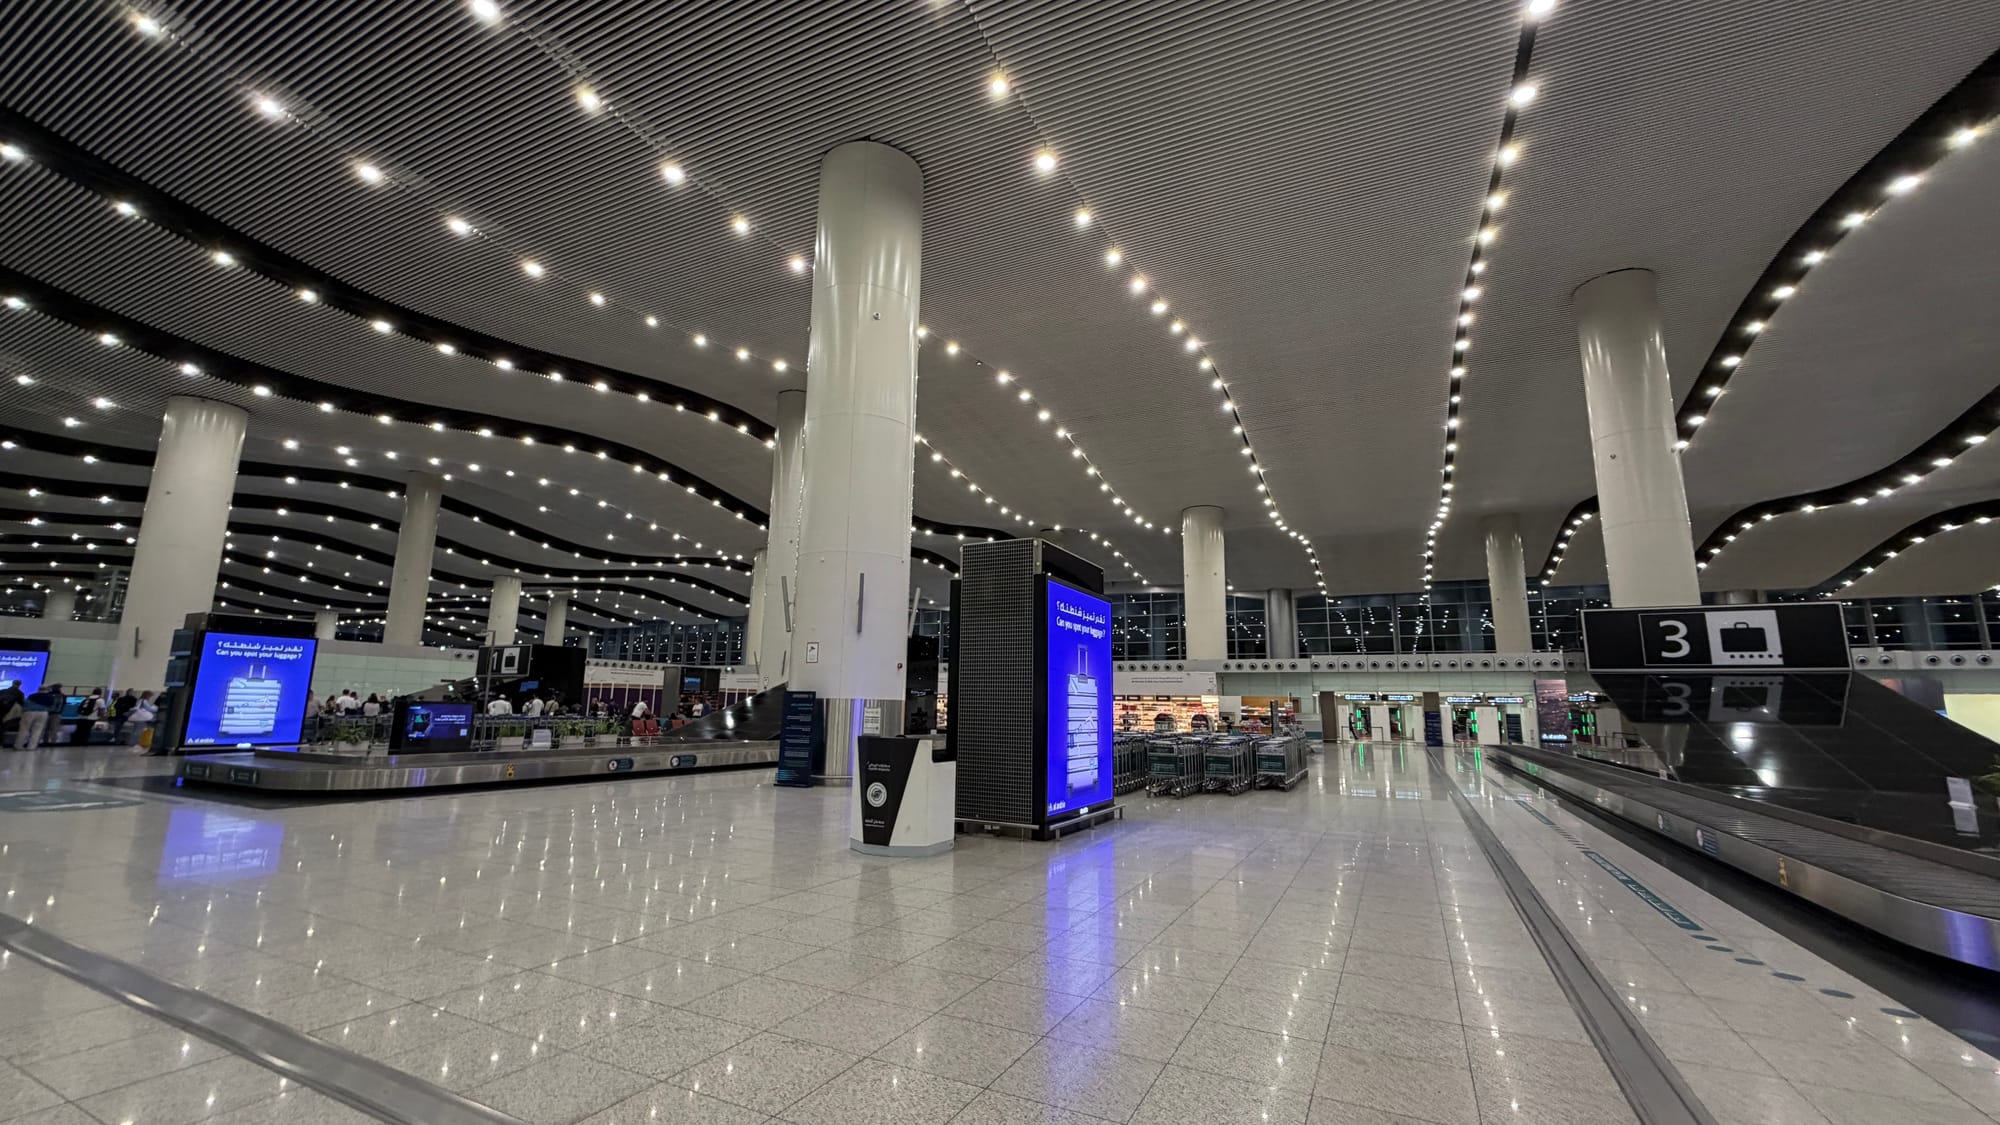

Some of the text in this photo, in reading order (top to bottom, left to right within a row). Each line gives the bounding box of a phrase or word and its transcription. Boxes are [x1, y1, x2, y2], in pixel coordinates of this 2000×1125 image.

[1056, 616, 1065, 627] Can
[1065, 620, 1073, 631] you
[1658, 619, 1691, 658] 3
[216, 648, 229, 656] Can
[230, 650, 243, 658] you
[244, 650, 258, 658] spot
[259, 651, 273, 659] your
